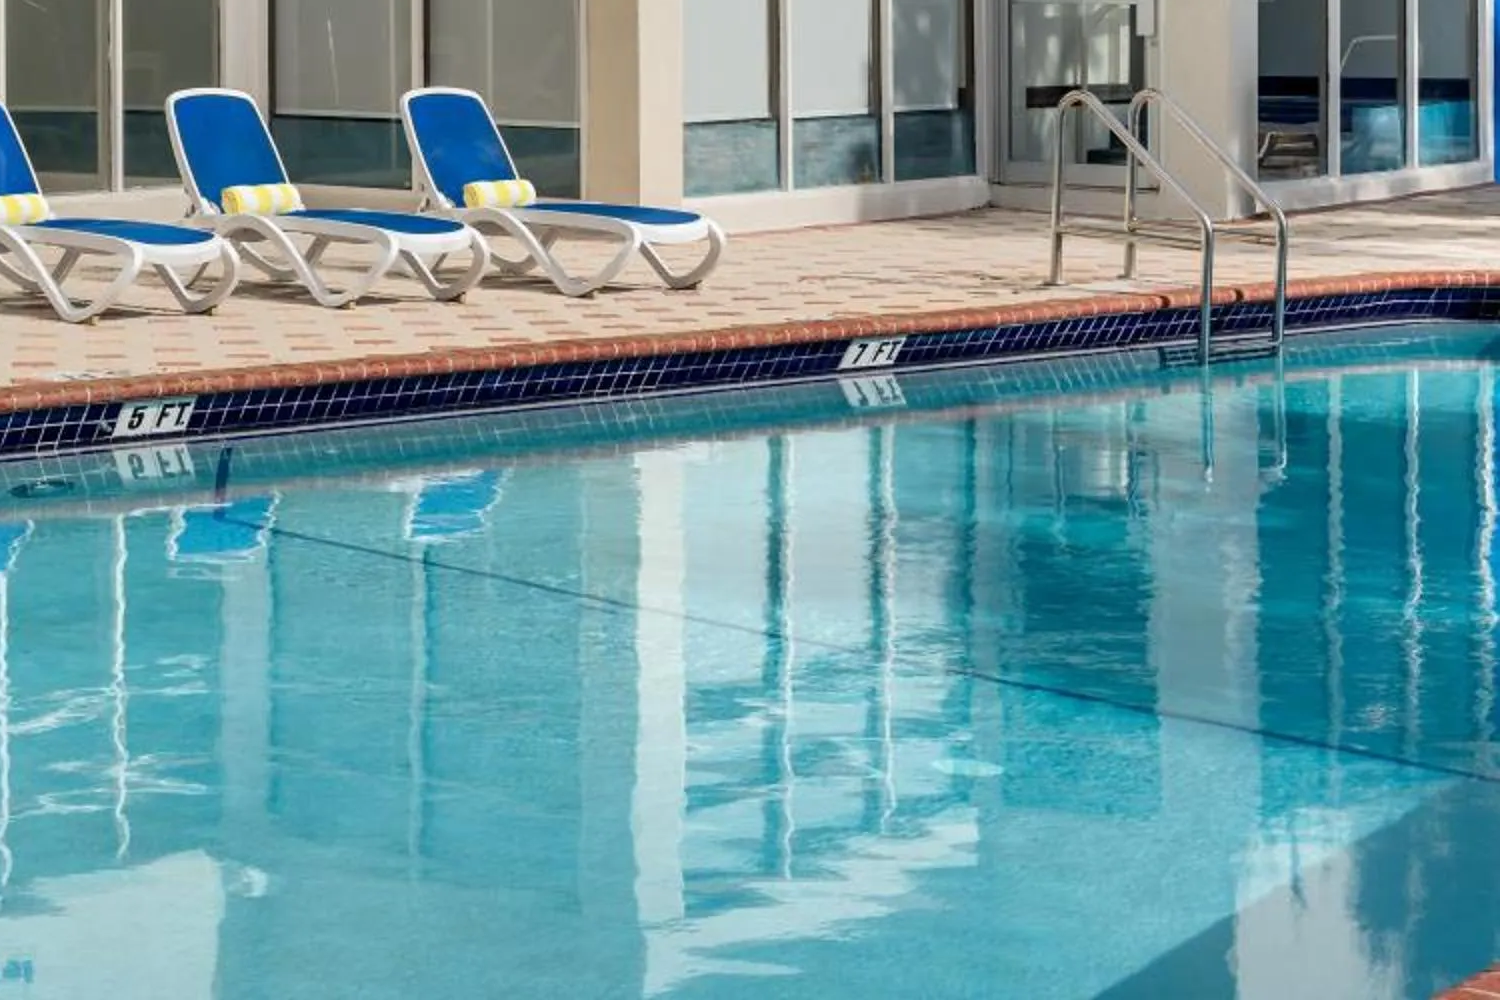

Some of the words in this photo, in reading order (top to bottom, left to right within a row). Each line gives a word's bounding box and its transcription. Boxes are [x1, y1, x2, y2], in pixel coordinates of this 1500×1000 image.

[851, 343, 869, 365] 7
[128, 405, 149, 430] 5
[156, 402, 192, 428] FT.
